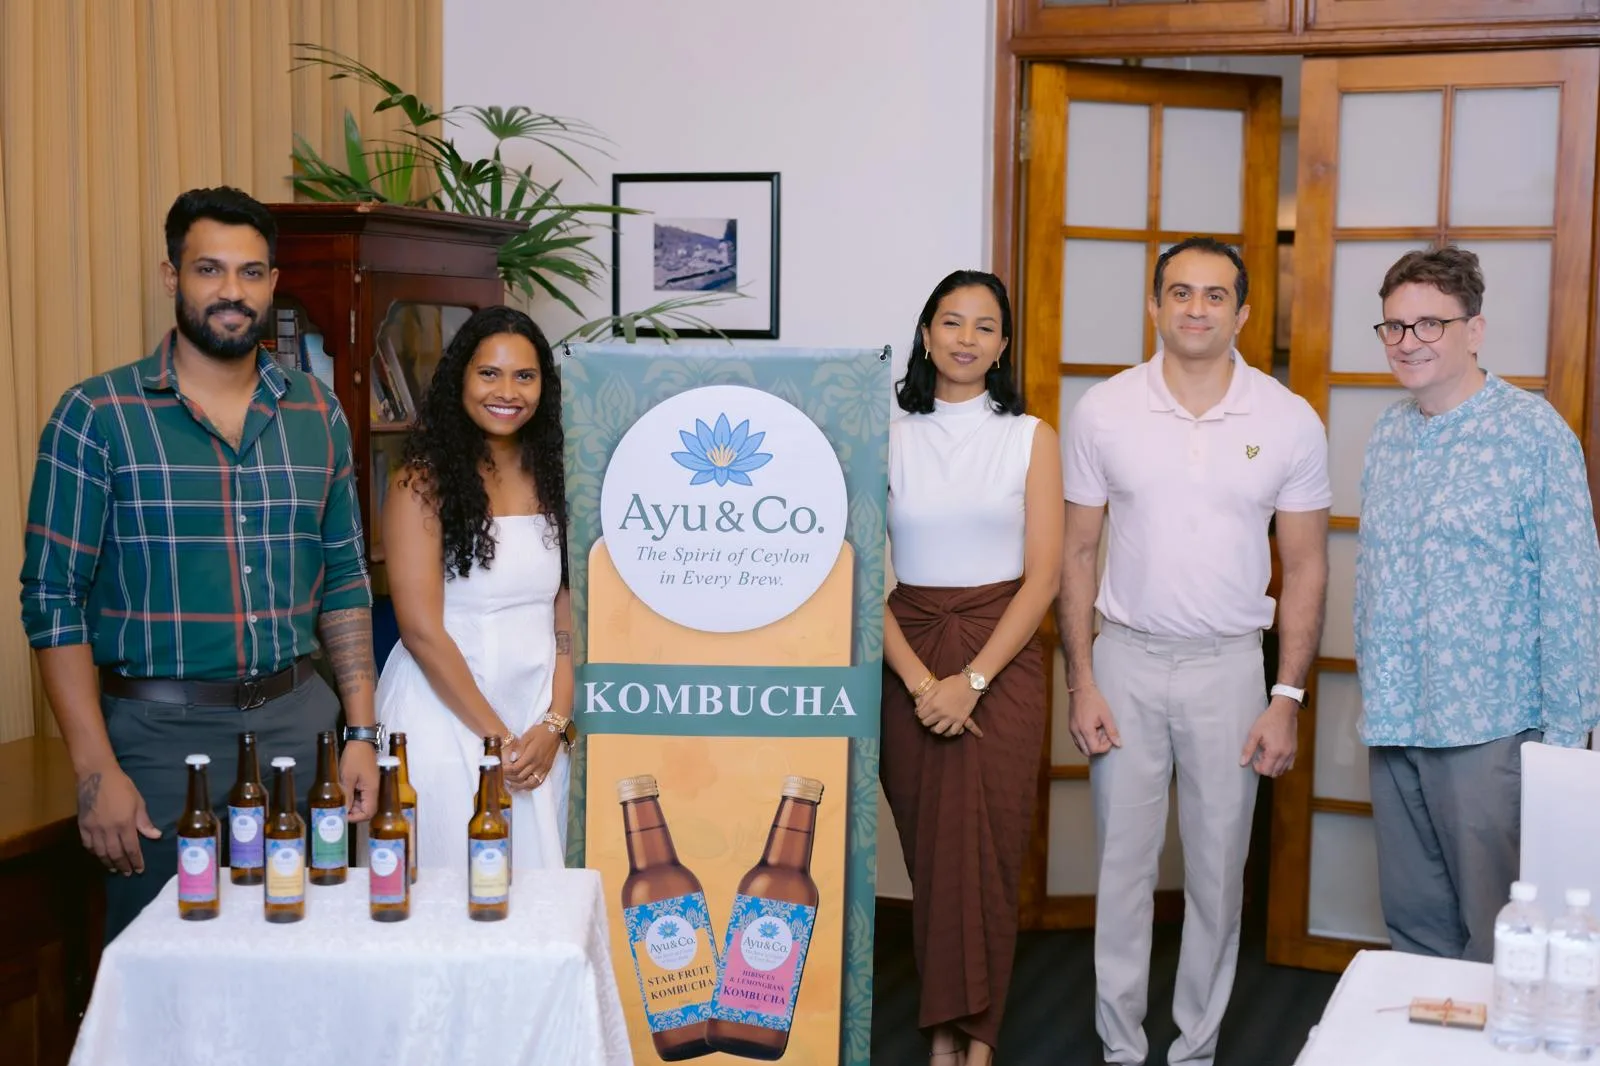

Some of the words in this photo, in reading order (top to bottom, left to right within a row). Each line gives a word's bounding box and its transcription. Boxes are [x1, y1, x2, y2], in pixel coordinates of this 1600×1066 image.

[618, 493, 825, 541] Ayu&Co.
[636, 546, 669, 562] The
[673, 546, 721, 565] Spirit
[727, 547, 745, 566] of
[750, 548, 810, 567] Ceylon
[660, 570, 676, 585] in
[682, 570, 732, 587] Every
[738, 570, 784, 587] Brew.
[583, 681, 857, 717] KOMBUCHA
[648, 973, 675, 986] STAR
[678, 965, 711, 980] FRUIT
[651, 978, 715, 1000] KOMBUCHA
[723, 985, 785, 1005] KOMBUCHA
